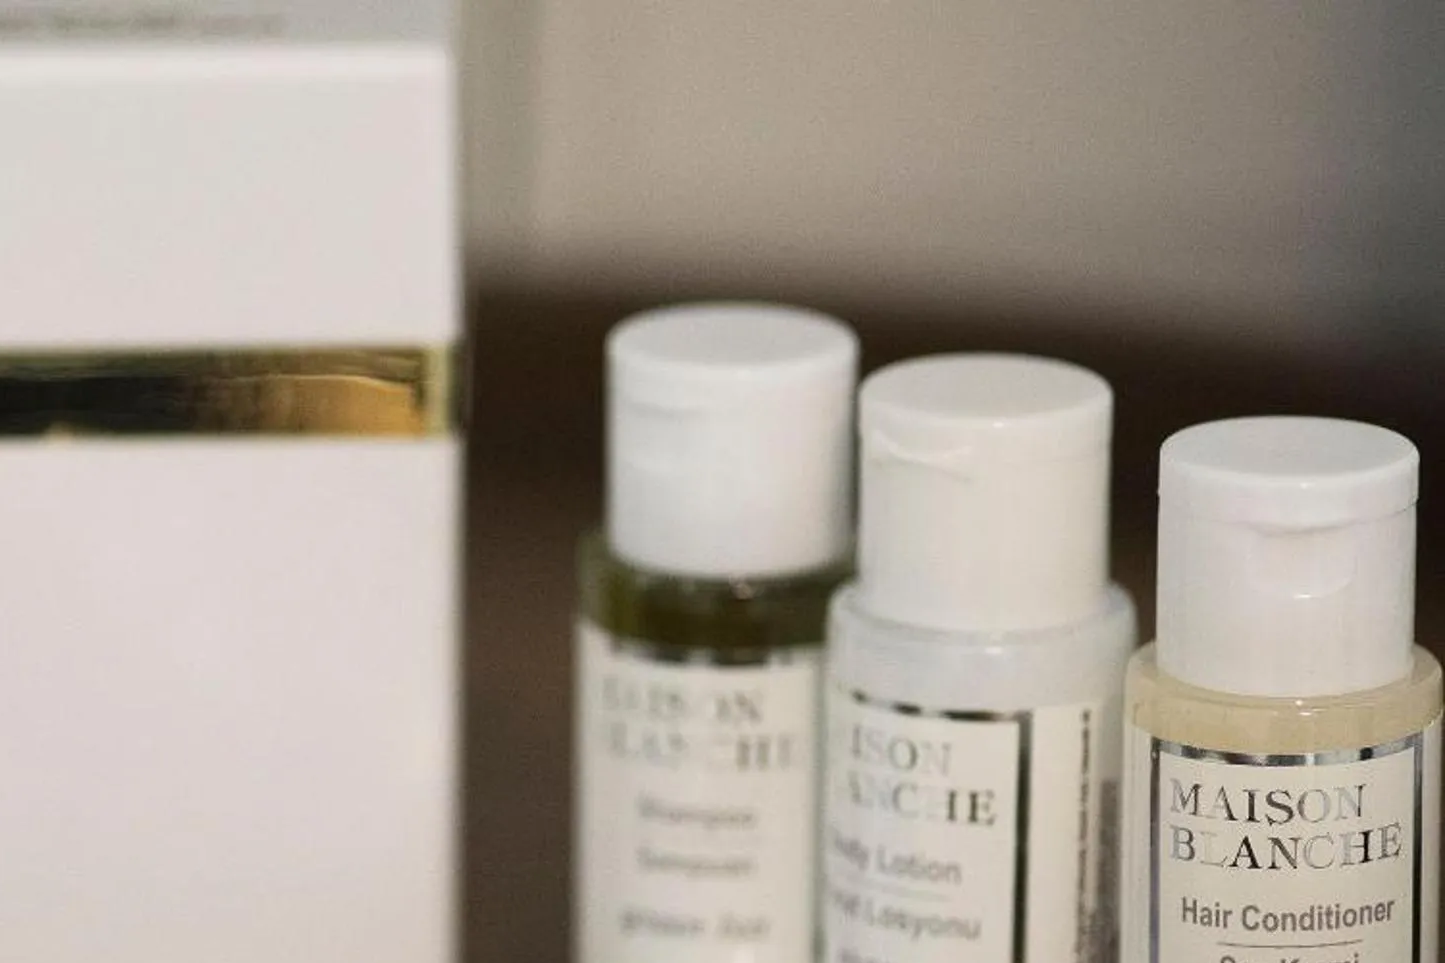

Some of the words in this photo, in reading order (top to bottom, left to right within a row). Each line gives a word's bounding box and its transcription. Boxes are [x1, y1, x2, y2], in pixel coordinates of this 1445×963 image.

[1169, 778, 1367, 826] MAISON
[1168, 821, 1403, 870] BLANCHE
[1181, 896, 1233, 930] Hair
[1241, 899, 1396, 933] Conditioner
